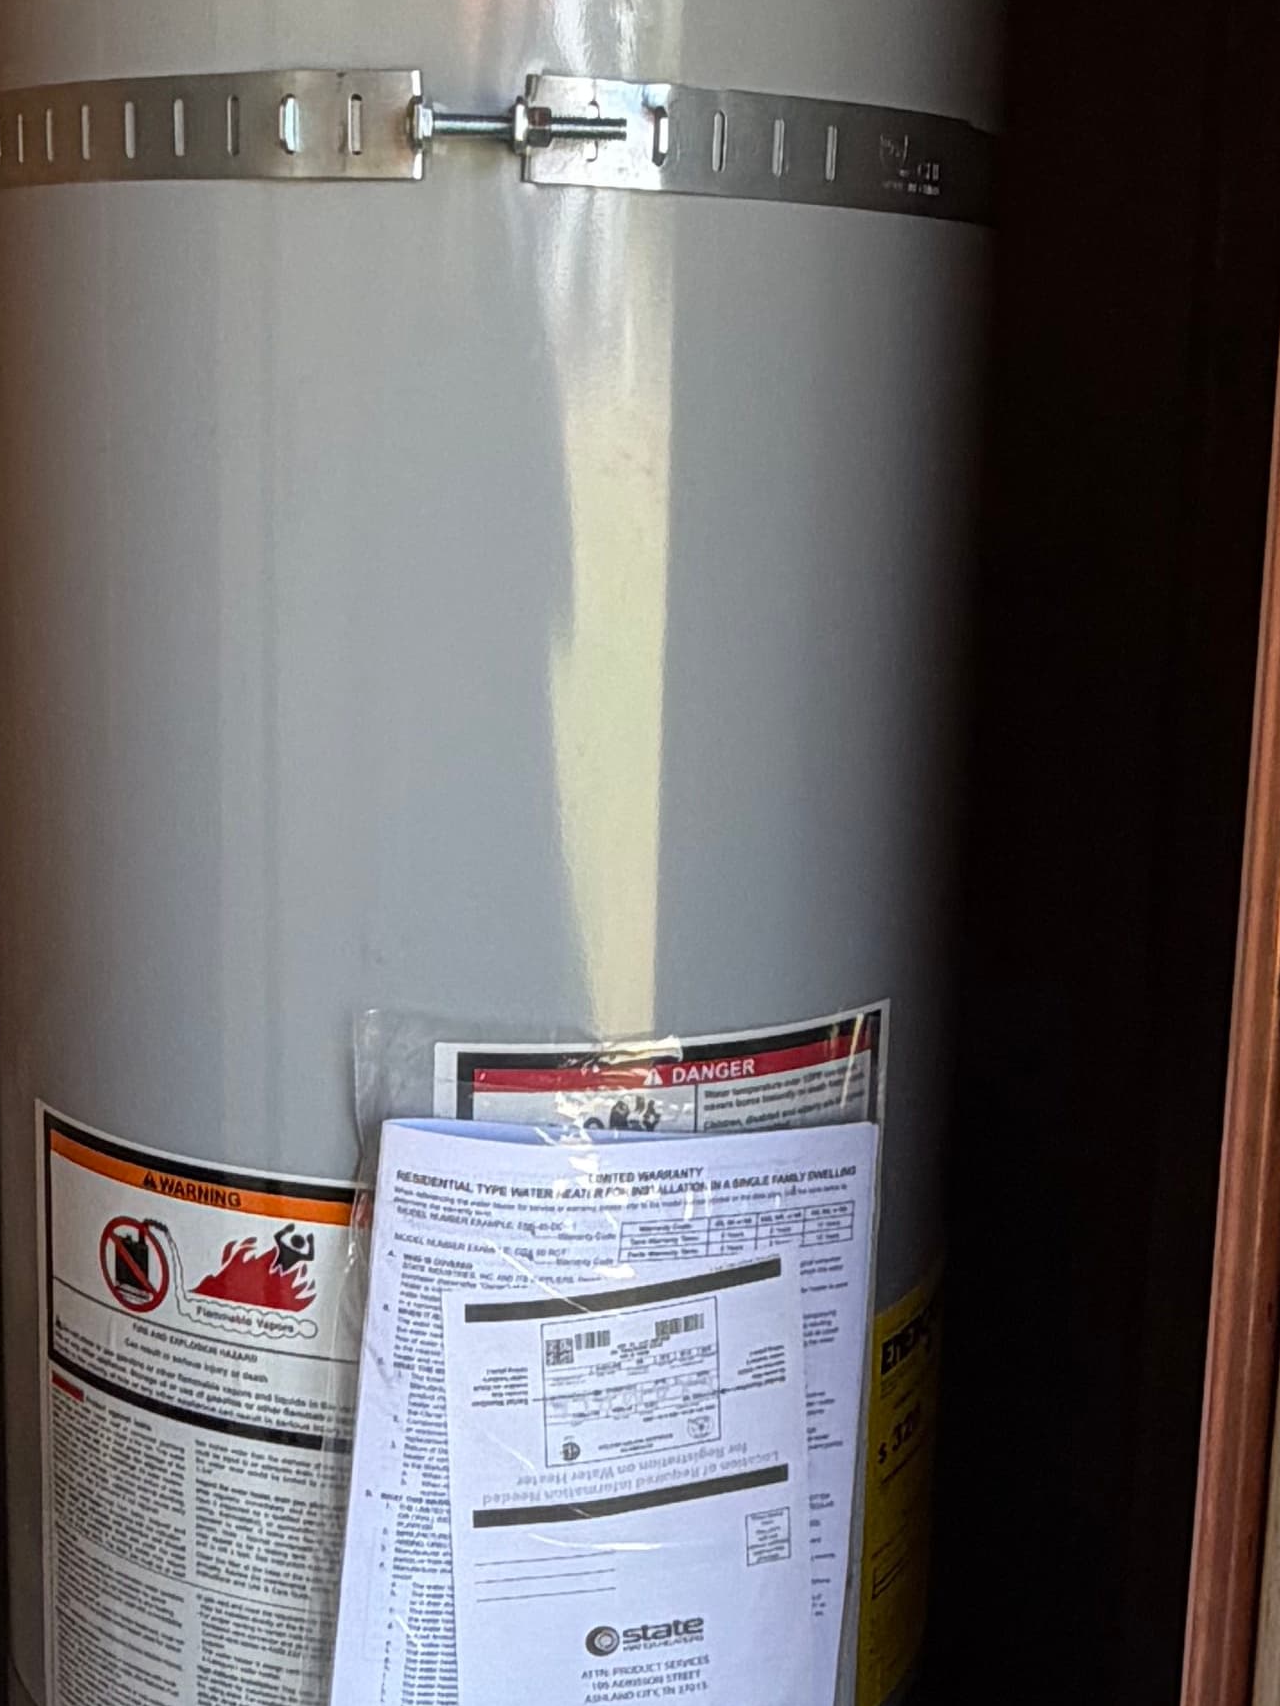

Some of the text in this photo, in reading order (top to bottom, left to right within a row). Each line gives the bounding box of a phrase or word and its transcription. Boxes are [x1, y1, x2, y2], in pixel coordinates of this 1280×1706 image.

[671, 1059, 756, 1085] DANGER
[156, 1173, 243, 1208] WARNING
[396, 1169, 474, 1192] RESIDENTIAL
[476, 1182, 508, 1198] TYPE
[510, 1186, 554, 1199] WATER
[709, 1179, 722, 1191] IN
[722, 1179, 731, 1190] A
[731, 1174, 771, 1189] SINGLE
[771, 1171, 806, 1185] FAMILY
[806, 1164, 858, 1183] DWELLING
[637, 1166, 705, 1184] WARRANTY
[195, 1305, 295, 1335] Flammable Vapors
[124, 1337, 141, 1349] Can
[142, 1342, 162, 1356] result
[172, 1354, 203, 1370] serious
[207, 1362, 229, 1378] injury
[242, 1370, 269, 1384] death
[152, 1329, 169, 1343] AND
[169, 1334, 218, 1356] EXPLOSION
[219, 1347, 258, 1364] HAZARD
[177, 1370, 220, 1391] flammable
[222, 1384, 252, 1400] vapors
[254, 1390, 273, 1402] and
[274, 1393, 306, 1410] liquids
[206, 1390, 242, 1408] gasoline
[257, 1399, 282, 1414] other
[177, 1394, 217, 1414] appliance
[275, 1417, 311, 1432] serious
[481, 1449, 780, 1508] Location of Required Information Needed
[515, 1441, 749, 1489] for Registration on Water Heater
[622, 1616, 705, 1644] state
[612, 1663, 662, 1678] PRODUCT
[664, 1654, 710, 1672] SERVICES
[666, 1668, 701, 1683] STREET
[584, 1689, 635, 1705] ASHLAND
